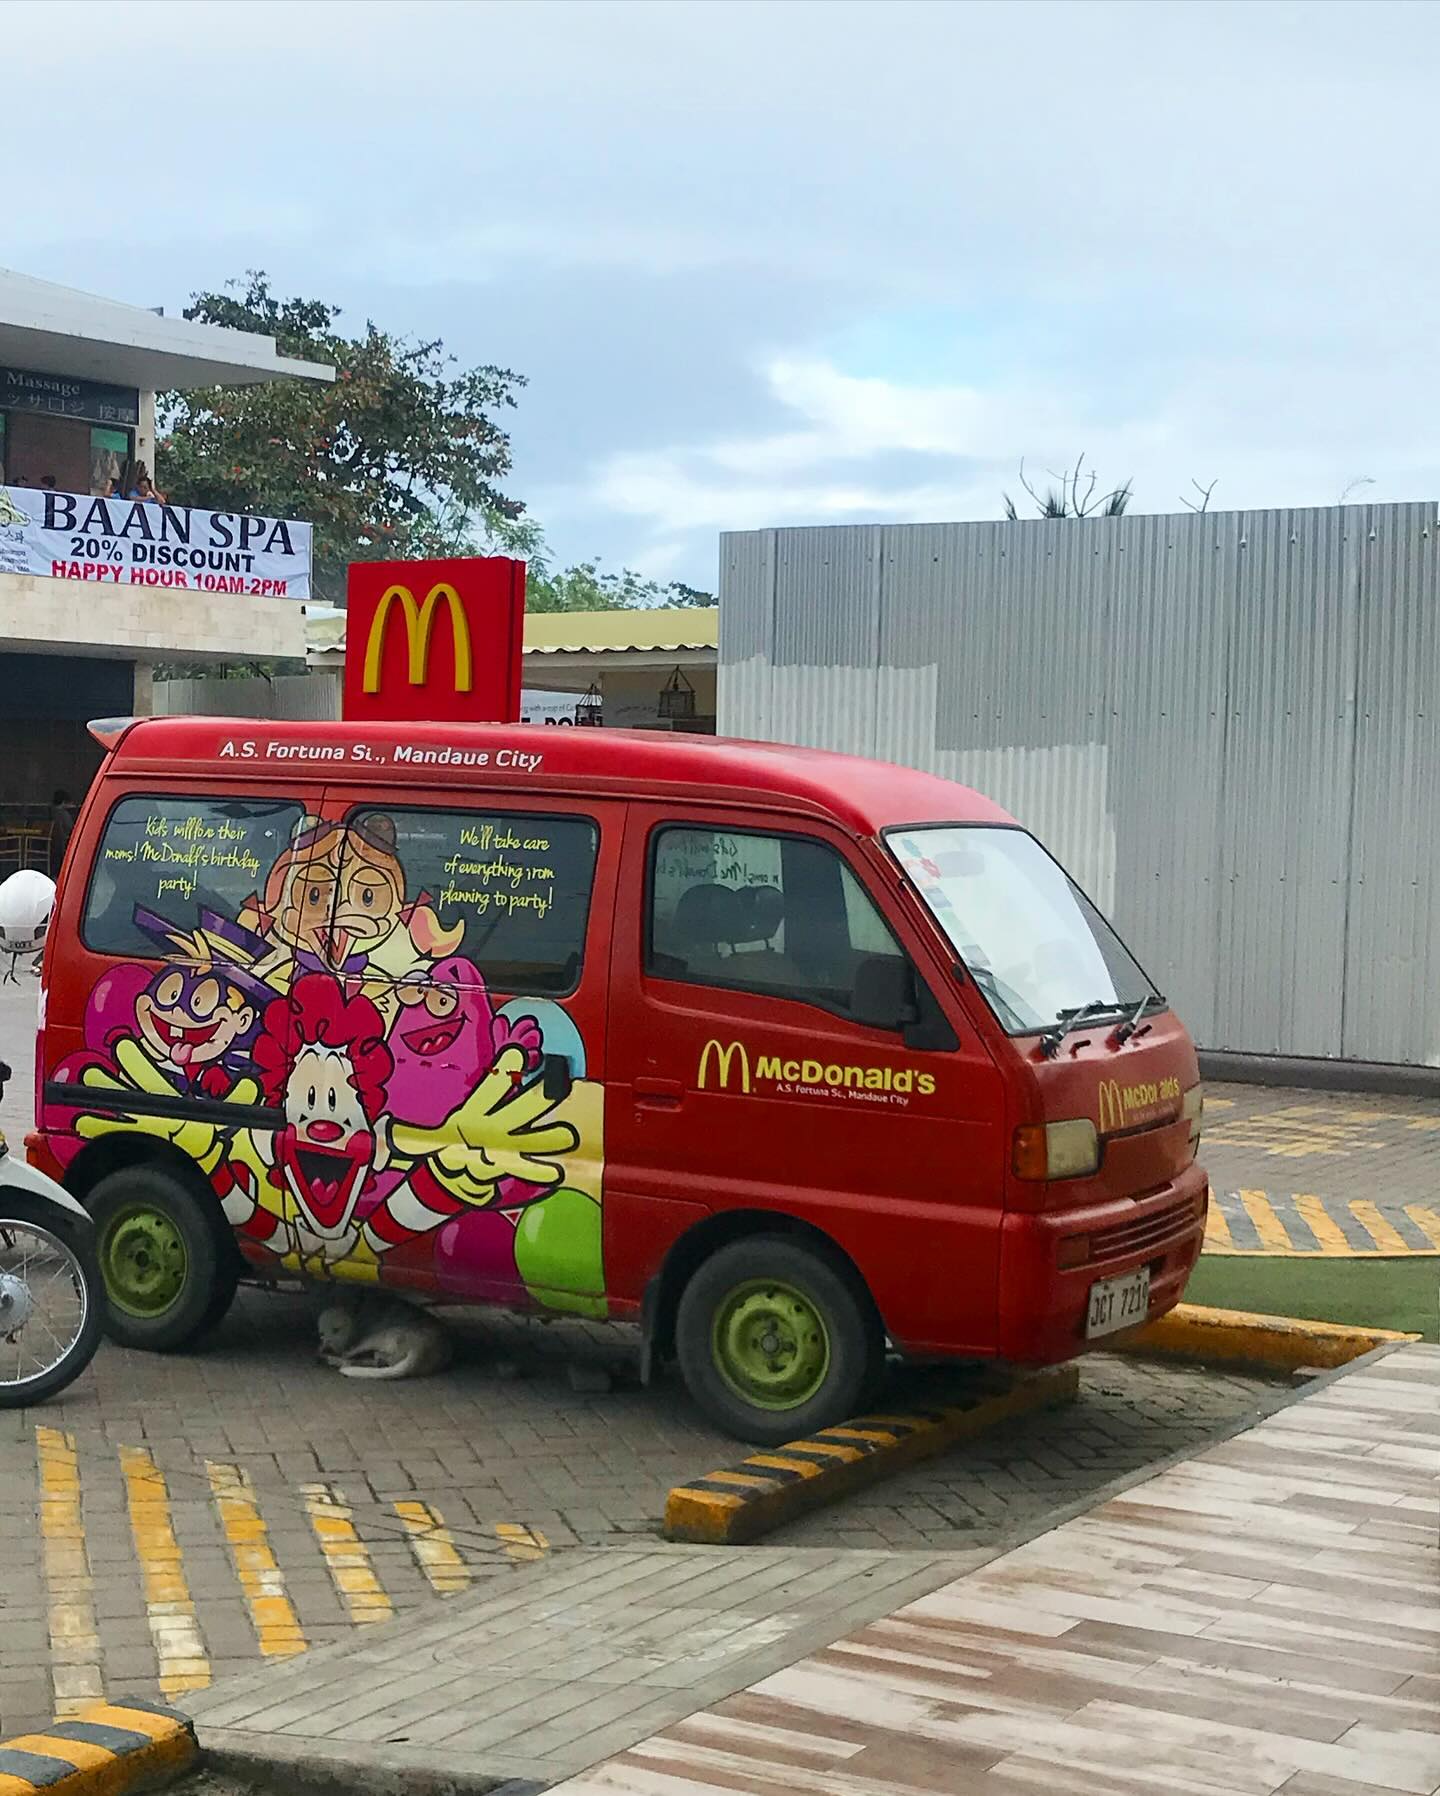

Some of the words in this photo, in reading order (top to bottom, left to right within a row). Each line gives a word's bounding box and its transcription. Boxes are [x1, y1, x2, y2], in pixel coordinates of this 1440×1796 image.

[7, 371, 80, 397] Massage
[41, 491, 193, 544] BAAN
[209, 512, 296, 556] SPA
[70, 537, 123, 562] 20%
[132, 543, 256, 573] DISCOUNT
[51, 559, 123, 584] HAPPY
[130, 567, 188, 589] HOUR
[195, 574, 288, 597] 10AM-2PM
[219, 741, 259, 759] A.S.
[265, 742, 345, 761] Fortuna
[393, 745, 489, 766] Mandaue
[495, 749, 543, 772] City
[145, 815, 169, 837] Kids
[218, 819, 247, 841] their
[460, 825, 493, 850] We'll
[494, 828, 521, 850] take
[523, 838, 550, 851] care
[105, 841, 138, 862] moms!
[140, 841, 208, 867] McDonald's
[211, 846, 260, 878] birthday
[444, 853, 461, 875] of
[459, 854, 524, 888] everything
[157, 870, 197, 900] party!
[439, 880, 490, 914] planning
[493, 890, 507, 906] to
[508, 886, 553, 919] party!
[755, 1055, 937, 1095] McDonald's
[795, 1084, 829, 1097] Fortuna
[848, 1090, 888, 1103] Mandaue
[890, 1094, 909, 1107] City
